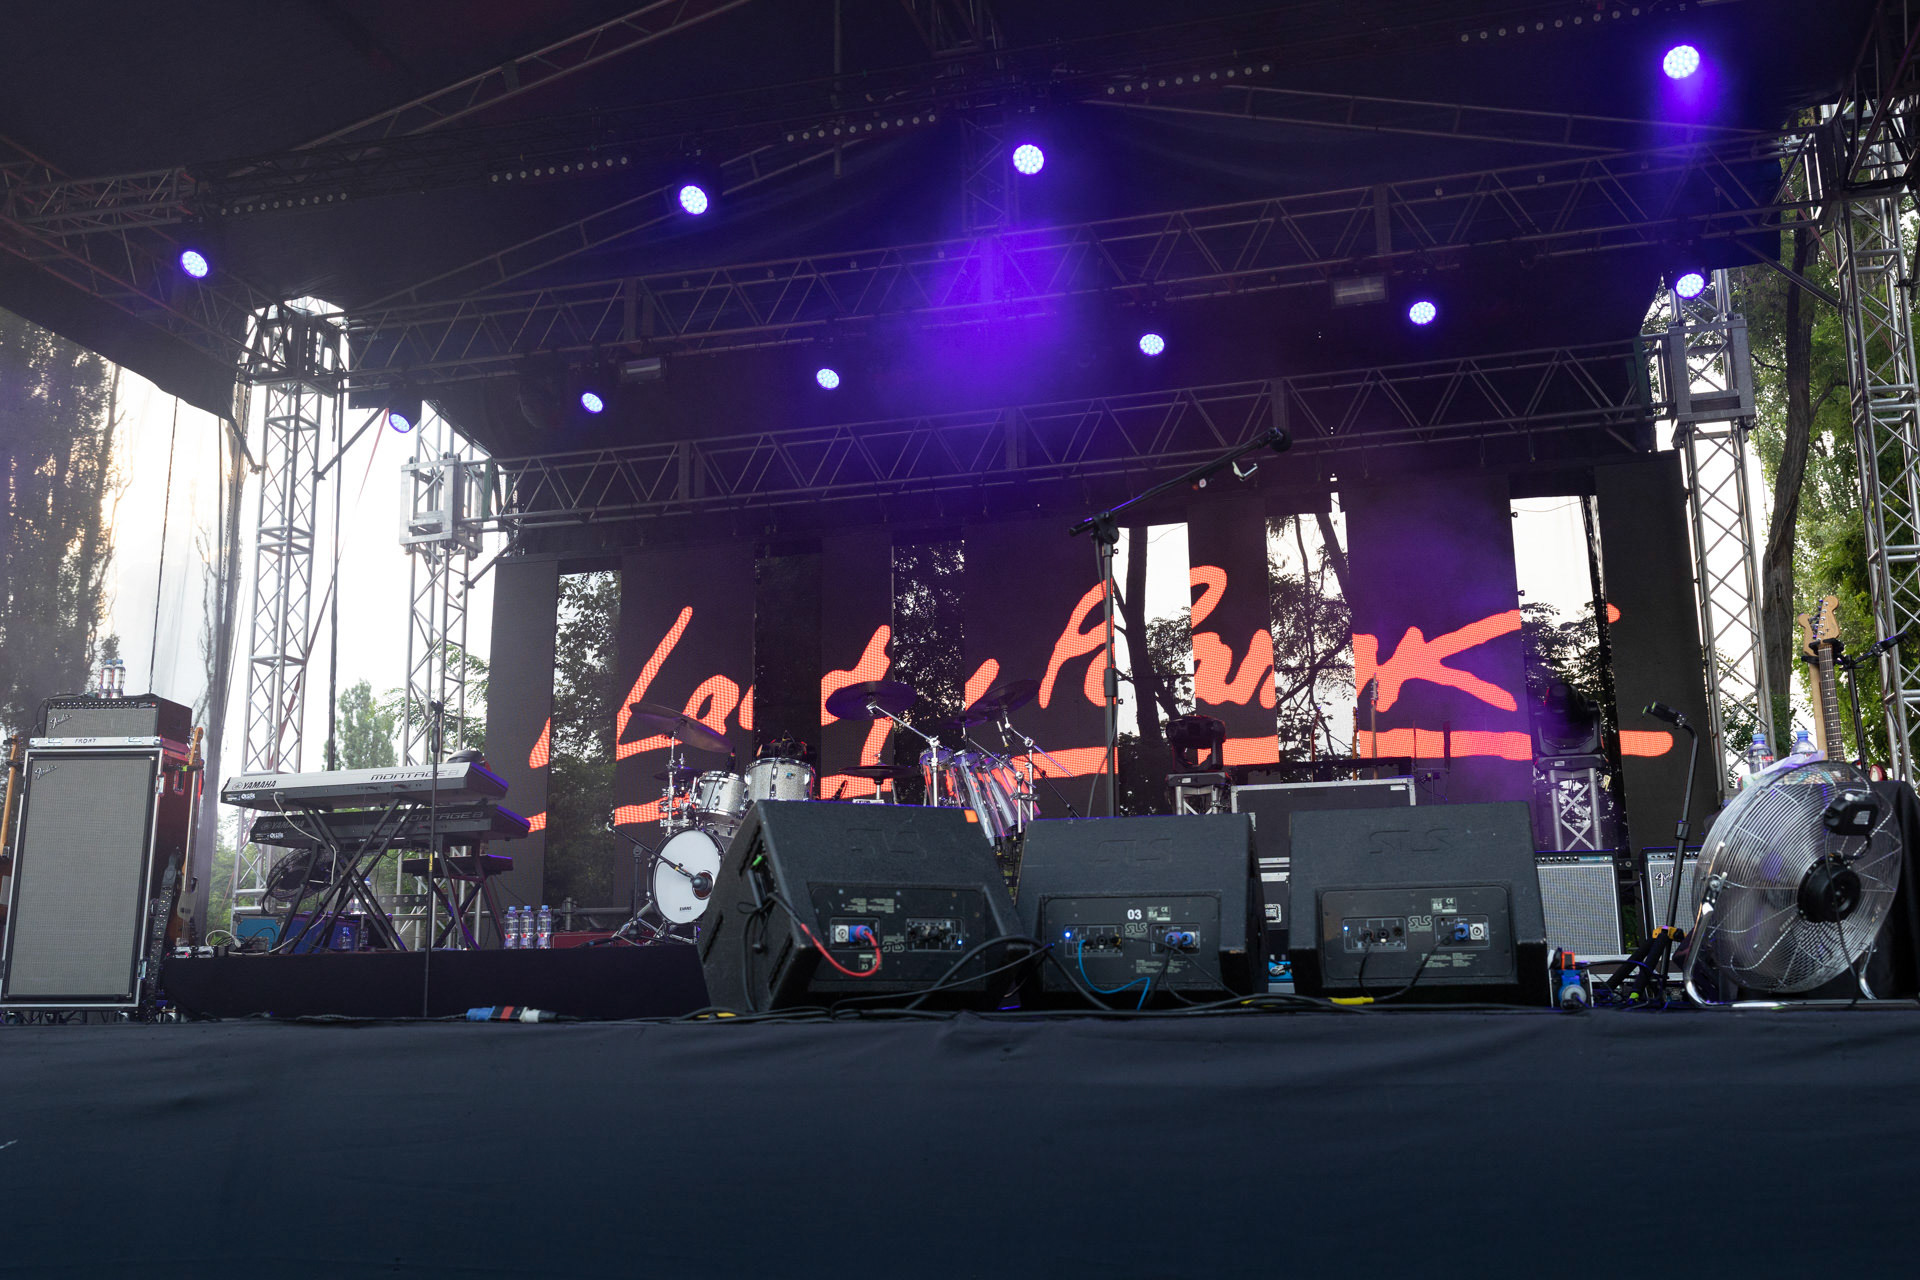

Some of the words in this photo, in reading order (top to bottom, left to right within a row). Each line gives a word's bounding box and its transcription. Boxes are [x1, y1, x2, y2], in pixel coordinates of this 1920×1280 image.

[242, 780, 277, 790] YAMAHA
[397, 812, 470, 822] ONAGE
[1127, 909, 1142, 920] 03
[1408, 915, 1433, 928] SLS
[1124, 922, 1148, 935] SLS
